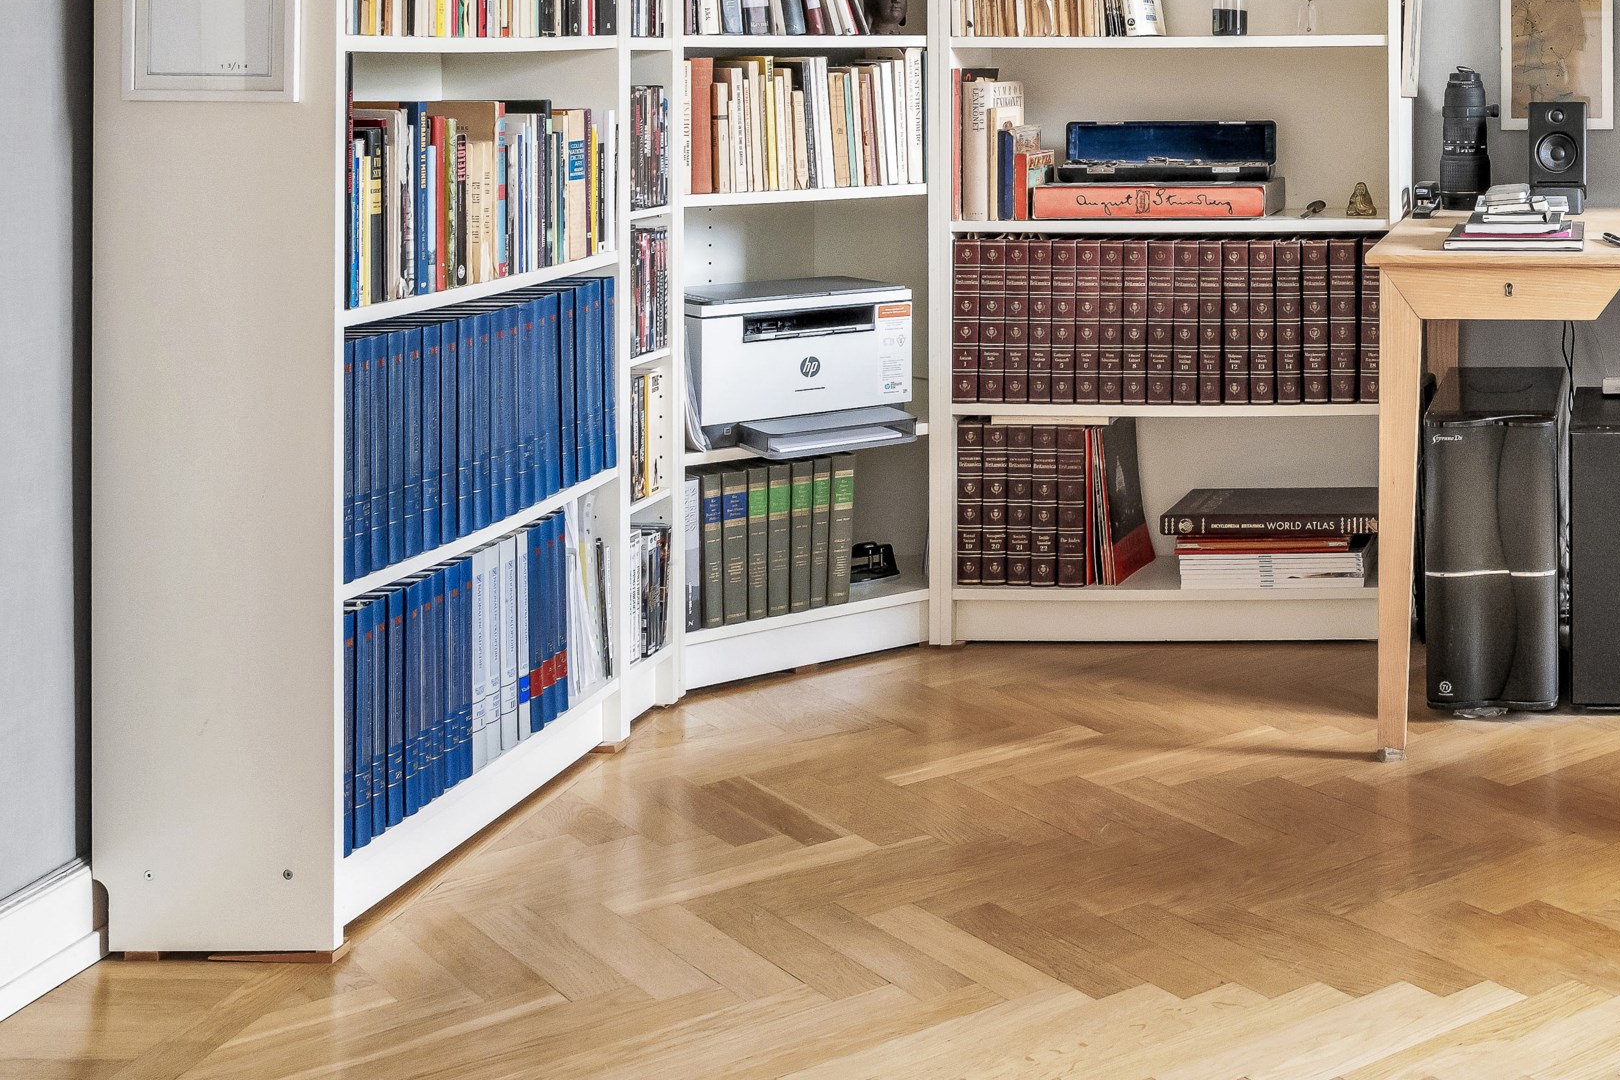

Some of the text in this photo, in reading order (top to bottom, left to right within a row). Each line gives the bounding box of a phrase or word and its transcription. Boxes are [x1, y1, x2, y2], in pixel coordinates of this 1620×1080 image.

[420, 154, 426, 162] VI
[1076, 194, 1133, 216] August
[801, 356, 820, 378] hp
[1266, 521, 1335, 530] WORLD ATLAS
